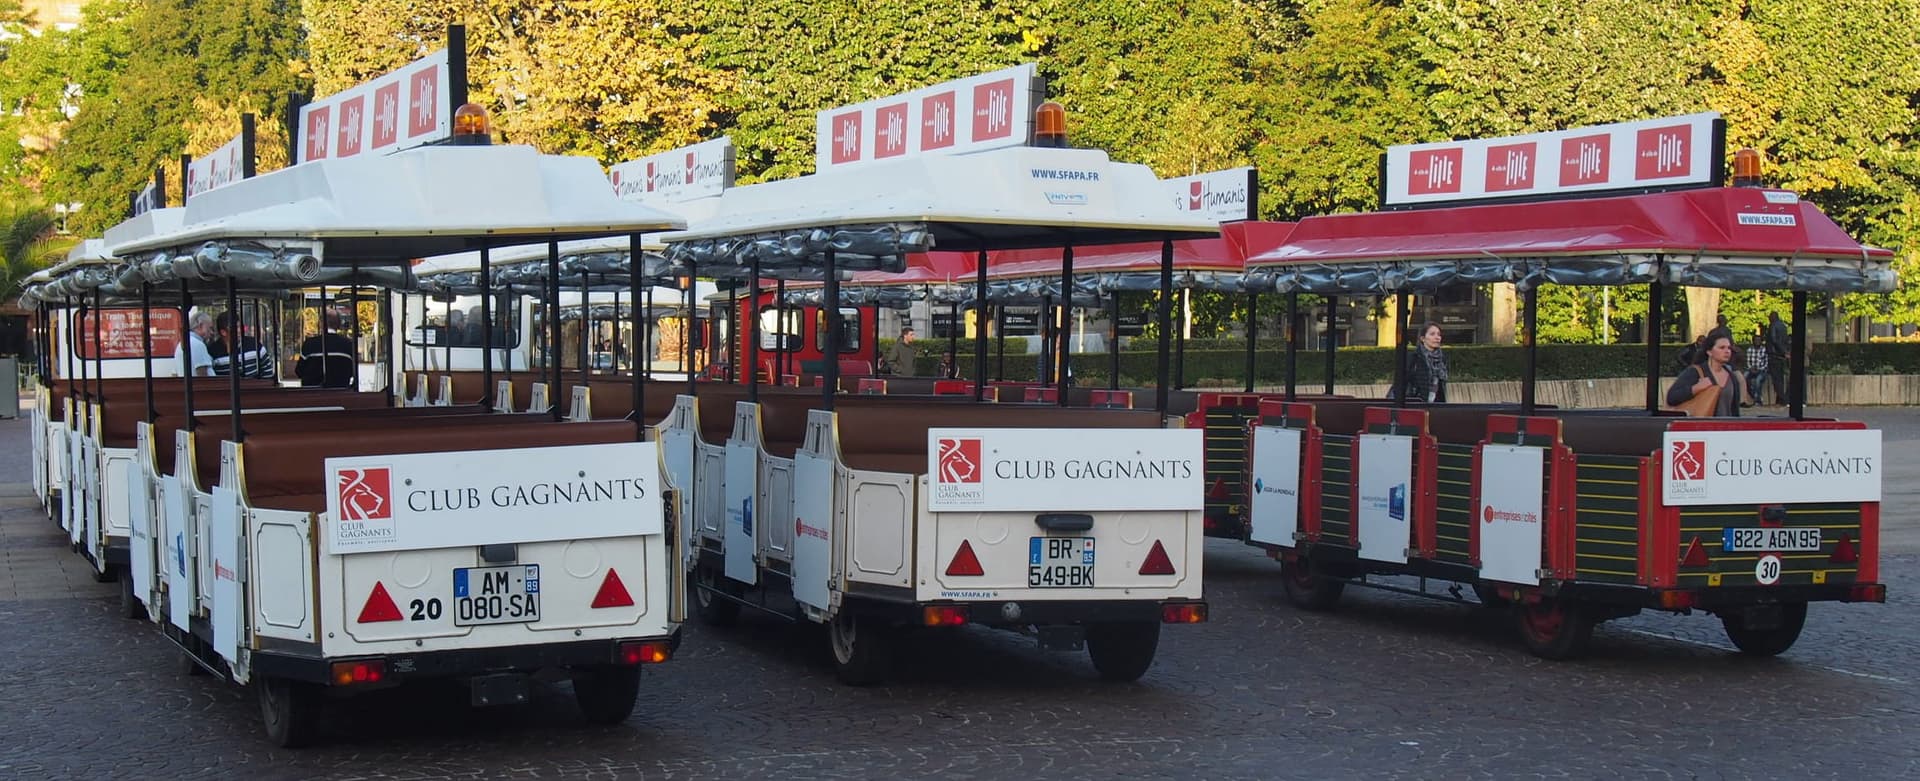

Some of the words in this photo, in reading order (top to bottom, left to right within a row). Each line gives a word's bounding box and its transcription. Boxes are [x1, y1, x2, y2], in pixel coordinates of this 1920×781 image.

[1031, 168, 1099, 181] WWW.SFAPA.FR
[1203, 180, 1246, 211] Humanis
[1740, 215, 1795, 225] WWW.SFAPA.FR
[995, 460, 1056, 479] CLUB
[1064, 460, 1192, 479] GAGNANTS
[1716, 458, 1763, 476] CLUB
[1769, 457, 1872, 476] GAGNANTS
[407, 488, 481, 512] CLUB
[491, 477, 646, 508] GAGNANTS
[340, 521, 365, 530] CLUB
[340, 529, 392, 538] GAGNANTS
[1734, 530, 1763, 548] 822
[1769, 530, 1797, 548] AGN
[1800, 530, 1818, 547] 95
[1761, 561, 1777, 579] 30
[526, 580, 539, 592] 89
[409, 598, 443, 621] 20
